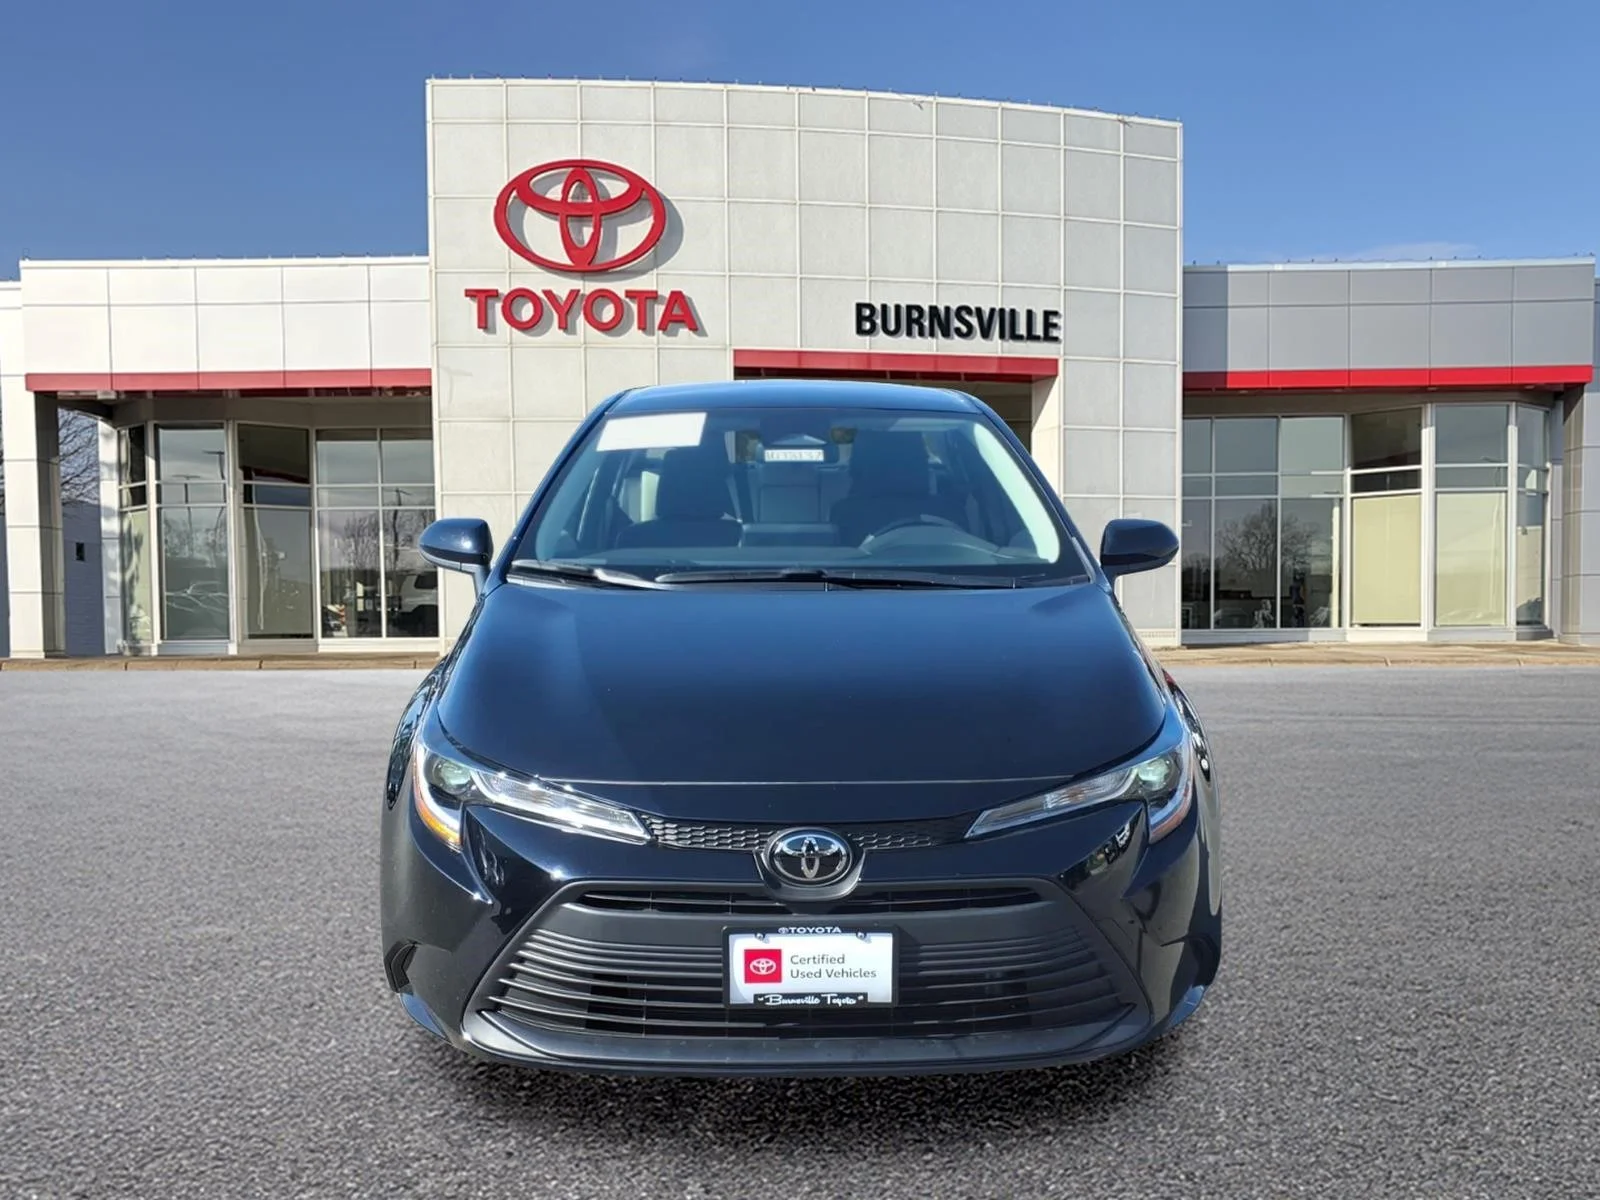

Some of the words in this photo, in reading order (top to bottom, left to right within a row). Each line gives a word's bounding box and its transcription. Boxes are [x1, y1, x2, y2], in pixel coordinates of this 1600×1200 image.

[464, 288, 698, 332] TOYOTA
[855, 302, 1061, 342] BURNSVILLE
[789, 926, 842, 934] TOYOTA
[790, 954, 846, 965] Certified
[790, 968, 823, 979] Used
[826, 967, 877, 979] Vehicles
